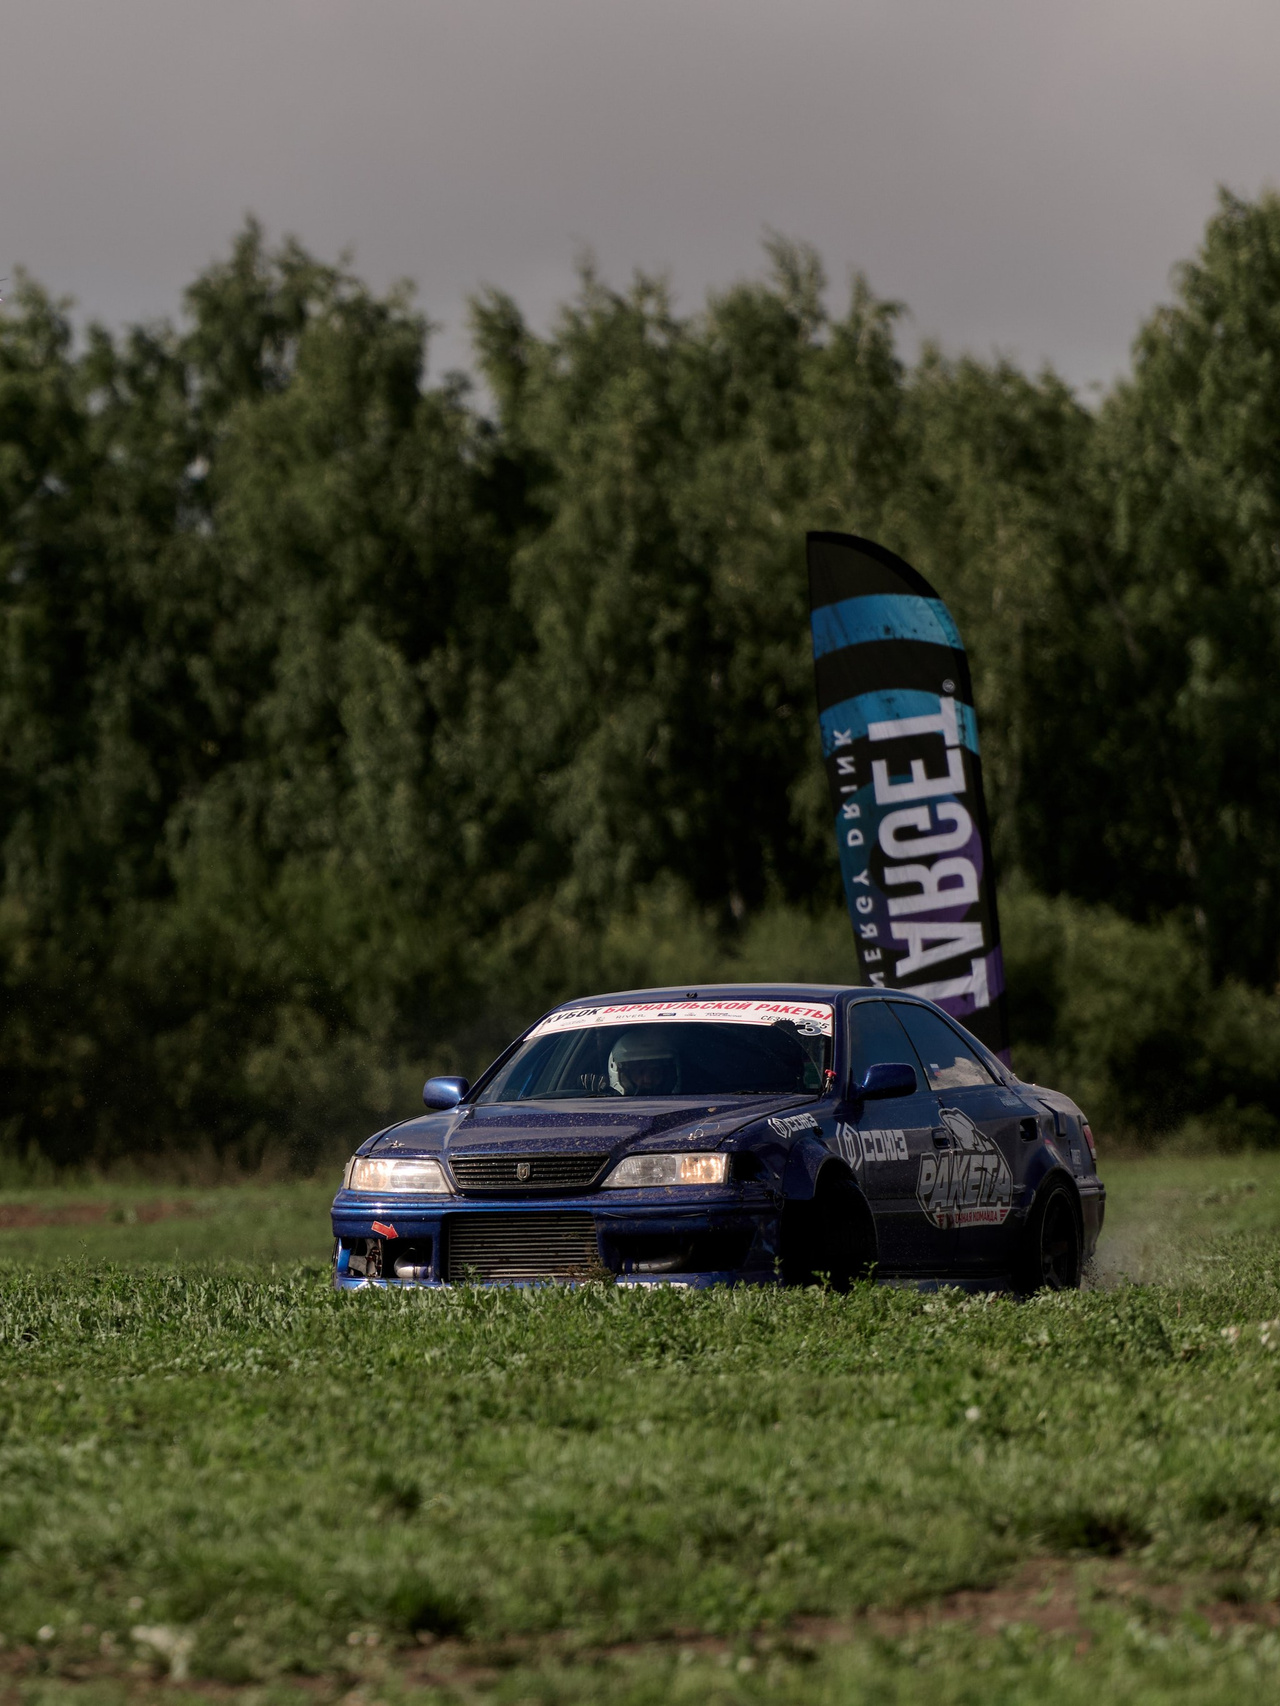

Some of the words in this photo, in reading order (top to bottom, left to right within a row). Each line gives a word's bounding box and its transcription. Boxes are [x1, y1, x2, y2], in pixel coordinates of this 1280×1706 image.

[546, 1008, 602, 1023] КУБОК
[603, 1002, 753, 1014] БАРНАУЛЬСКОЙ
[754, 1003, 833, 1020] РАКЕТЫ
[797, 1019, 822, 1036] 3
[859, 1130, 909, 1162] СОЮЗ
[920, 1154, 1012, 1210] РАКЕТА
